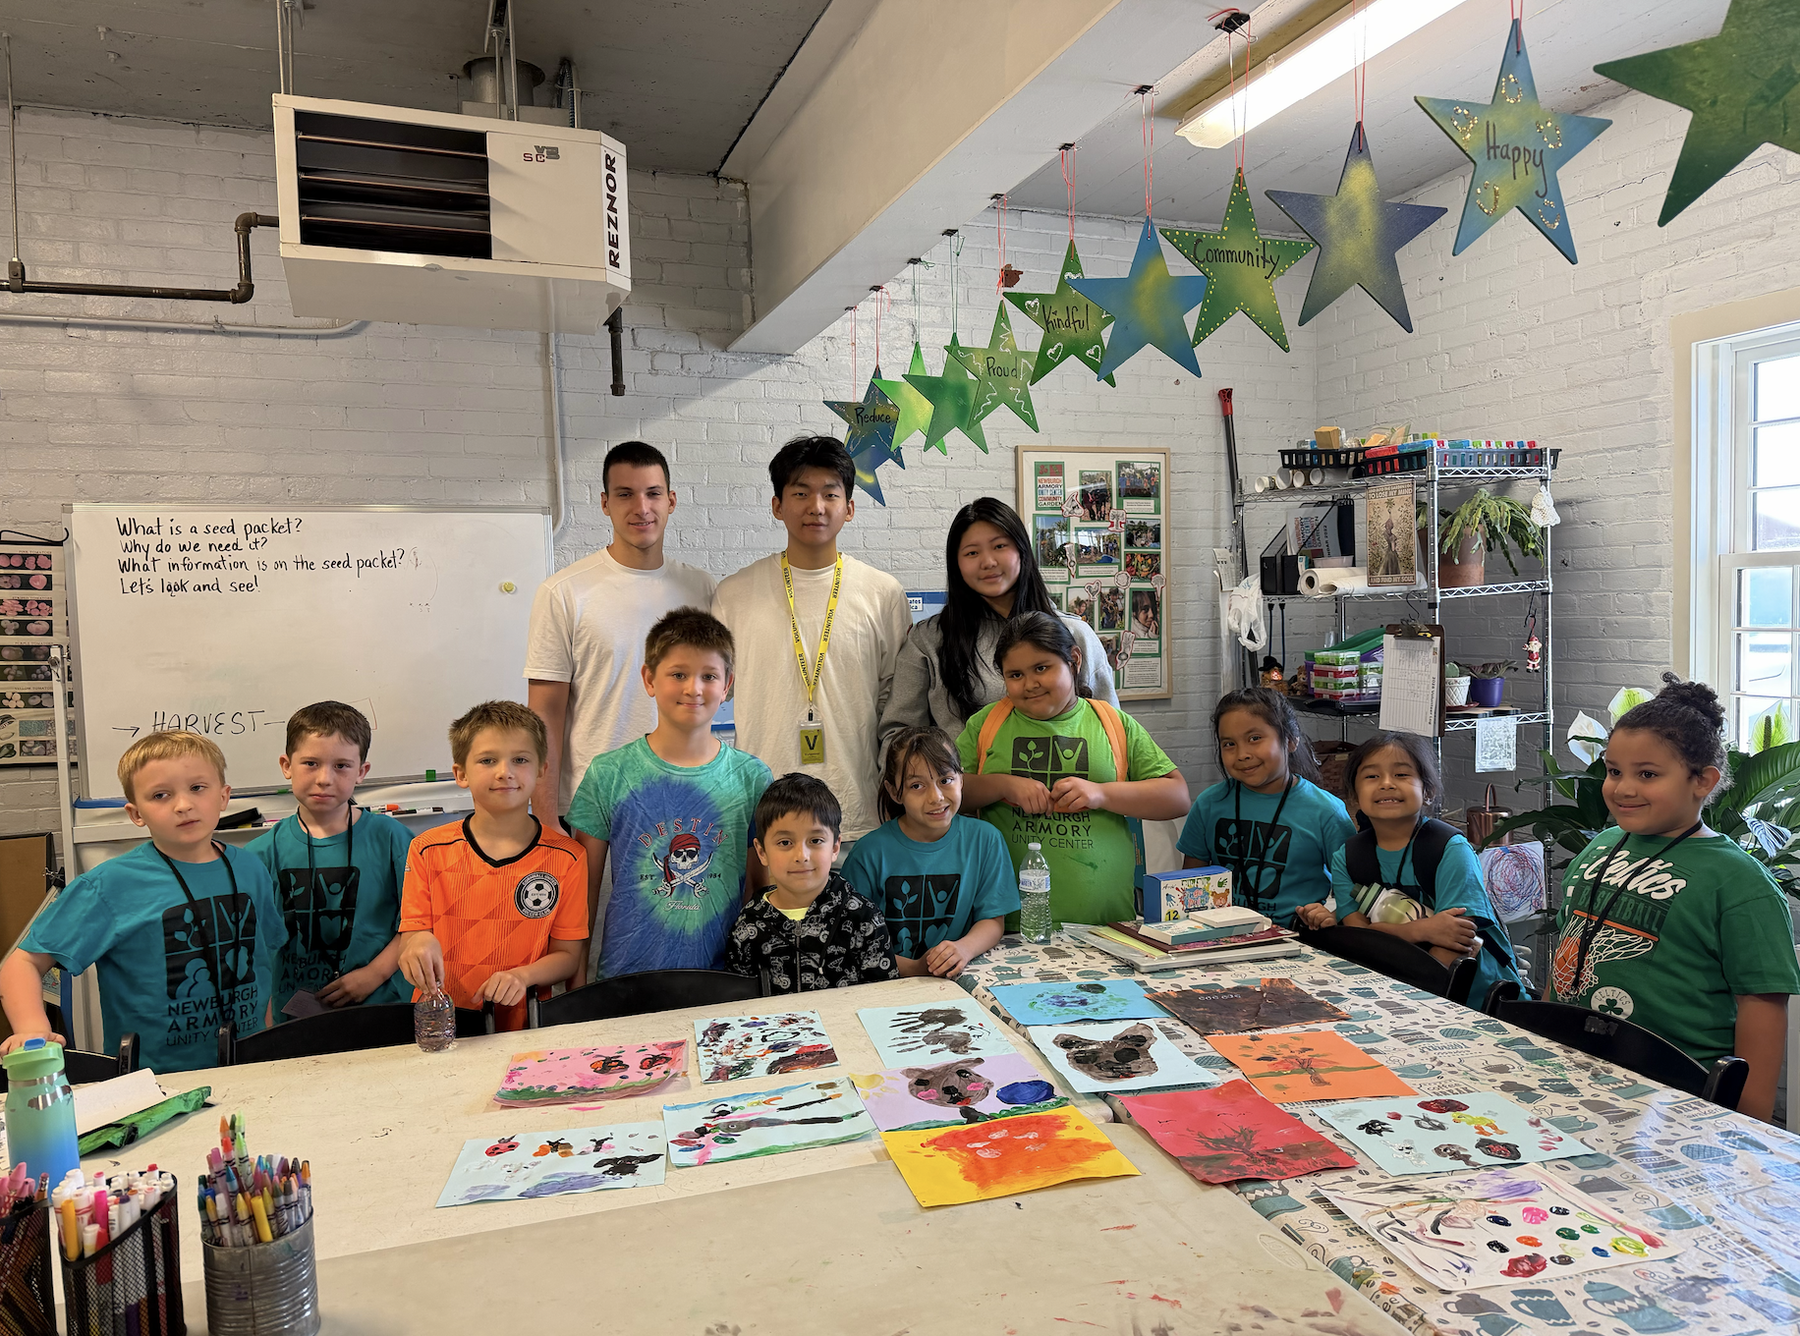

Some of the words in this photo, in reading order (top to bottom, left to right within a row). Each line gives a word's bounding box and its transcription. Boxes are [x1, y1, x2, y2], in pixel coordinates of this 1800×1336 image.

[1486, 120, 1549, 199] Happy
[605, 153, 620, 269] REZNOR
[1193, 238, 1280, 280] Community
[1042, 303, 1090, 334] Kindful
[986, 356, 1019, 378] Proud
[855, 407, 891, 424] Reduce
[116, 517, 164, 536] What
[170, 518, 182, 535] is
[190, 525, 198, 534] a
[203, 518, 236, 534] seed
[244, 517, 303, 541] packet?
[120, 539, 150, 561] Why
[155, 538, 171, 553] do
[179, 541, 201, 552] we
[208, 538, 243, 552] need
[249, 536, 268, 550] it?
[118, 556, 161, 573] What
[168, 554, 249, 572] information
[257, 557, 268, 571] is
[273, 559, 288, 571] on
[293, 554, 316, 571] the
[322, 552, 352, 569] seed
[357, 548, 405, 578] packet?
[120, 577, 154, 595] Let's
[161, 577, 189, 597] look
[193, 577, 222, 594] and
[229, 574, 262, 593] see!
[832, 567, 842, 599] VOLUNTEER
[823, 608, 834, 643] VOLUNTEER
[813, 652, 825, 687] VOLUNTEER
[152, 710, 265, 735] HARVEST
[804, 735, 818, 750] V
[638, 817, 728, 848] DESTIN
[1012, 820, 1091, 837] ARMORY
[1012, 834, 1045, 845] UNITY
[1049, 837, 1094, 850] CENTER
[1583, 850, 1688, 900] Celtics
[664, 900, 701, 912] Florida
[1166, 910, 1179, 921] 12
[168, 984, 258, 1016] NEWBURGH
[1594, 989, 1630, 1006] CELTICS
[167, 1001, 258, 1033] ARMORY
[166, 1030, 210, 1047] UNITY
